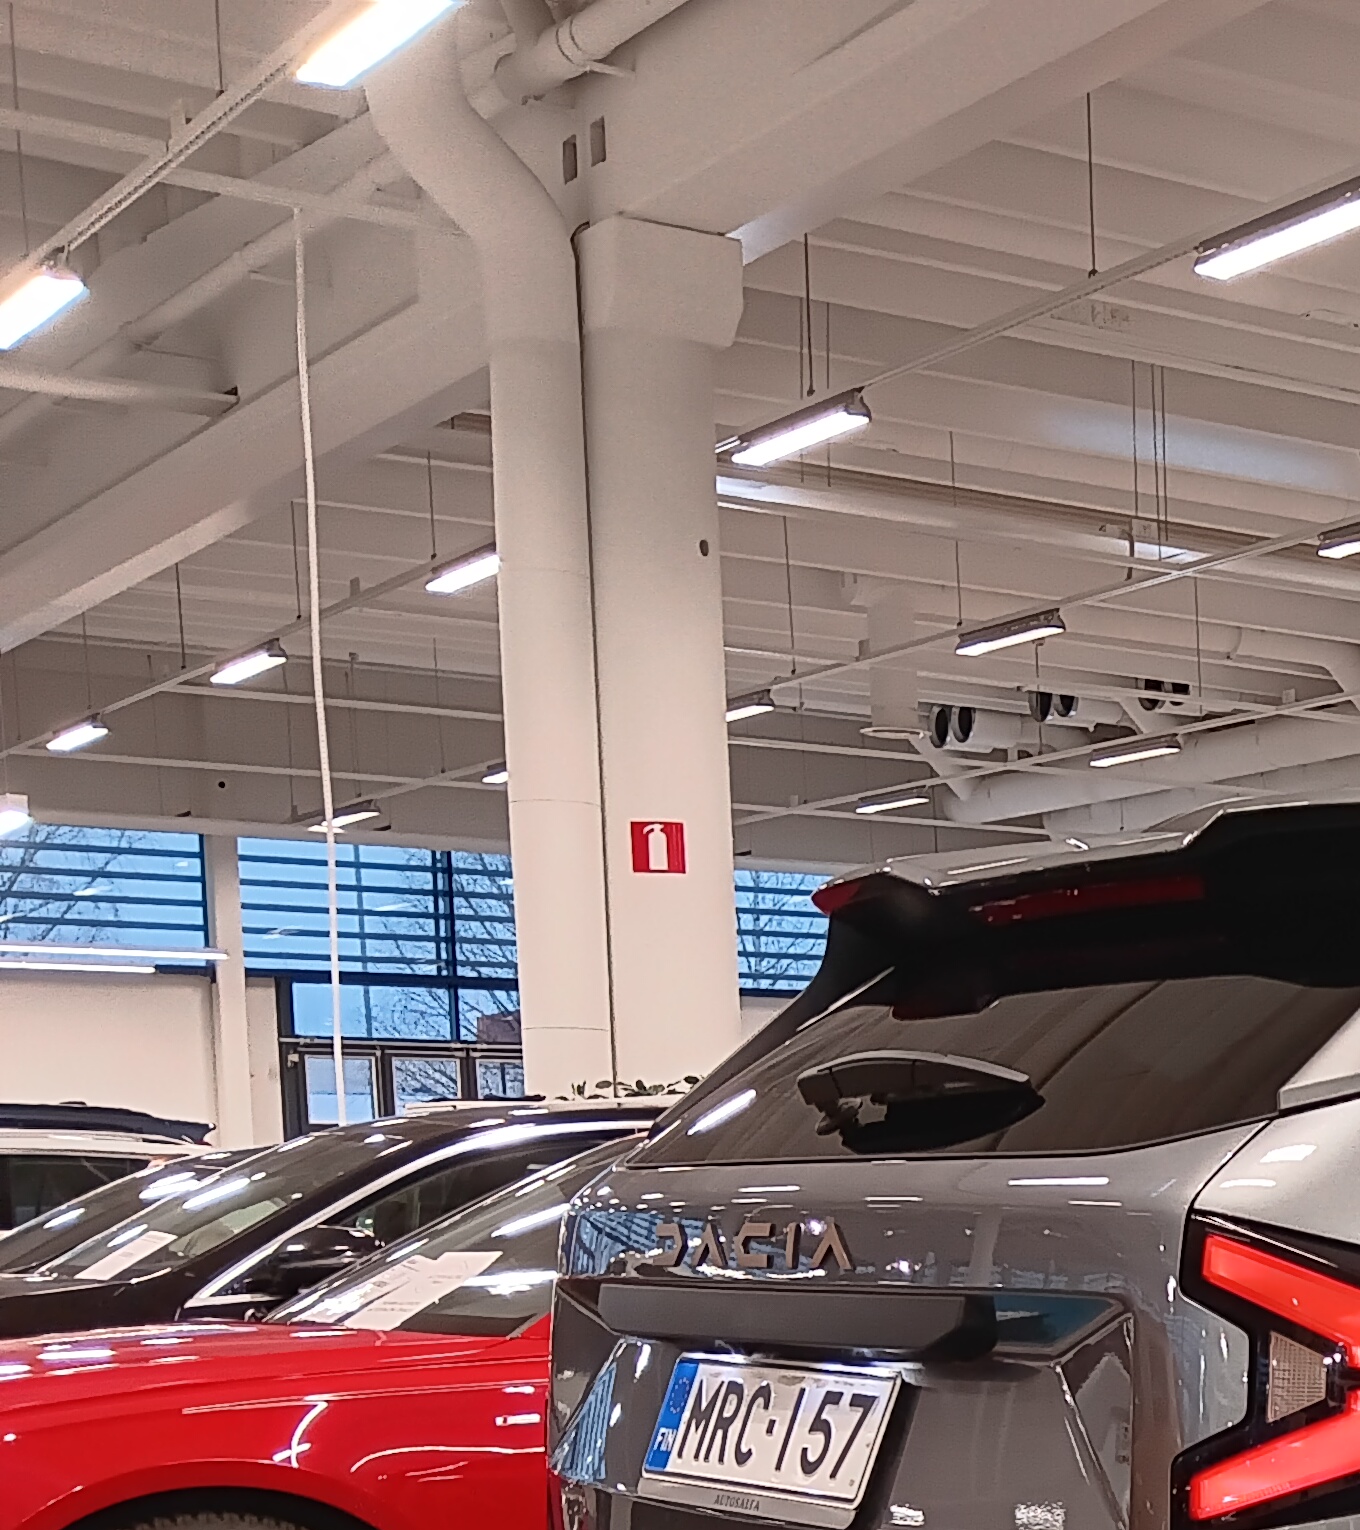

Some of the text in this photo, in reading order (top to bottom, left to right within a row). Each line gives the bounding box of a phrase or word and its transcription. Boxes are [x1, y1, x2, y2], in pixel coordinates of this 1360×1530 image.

[653, 1221, 853, 1268] DACIA
[653, 1427, 678, 1451] FIN
[677, 1379, 880, 1480] MRC-157
